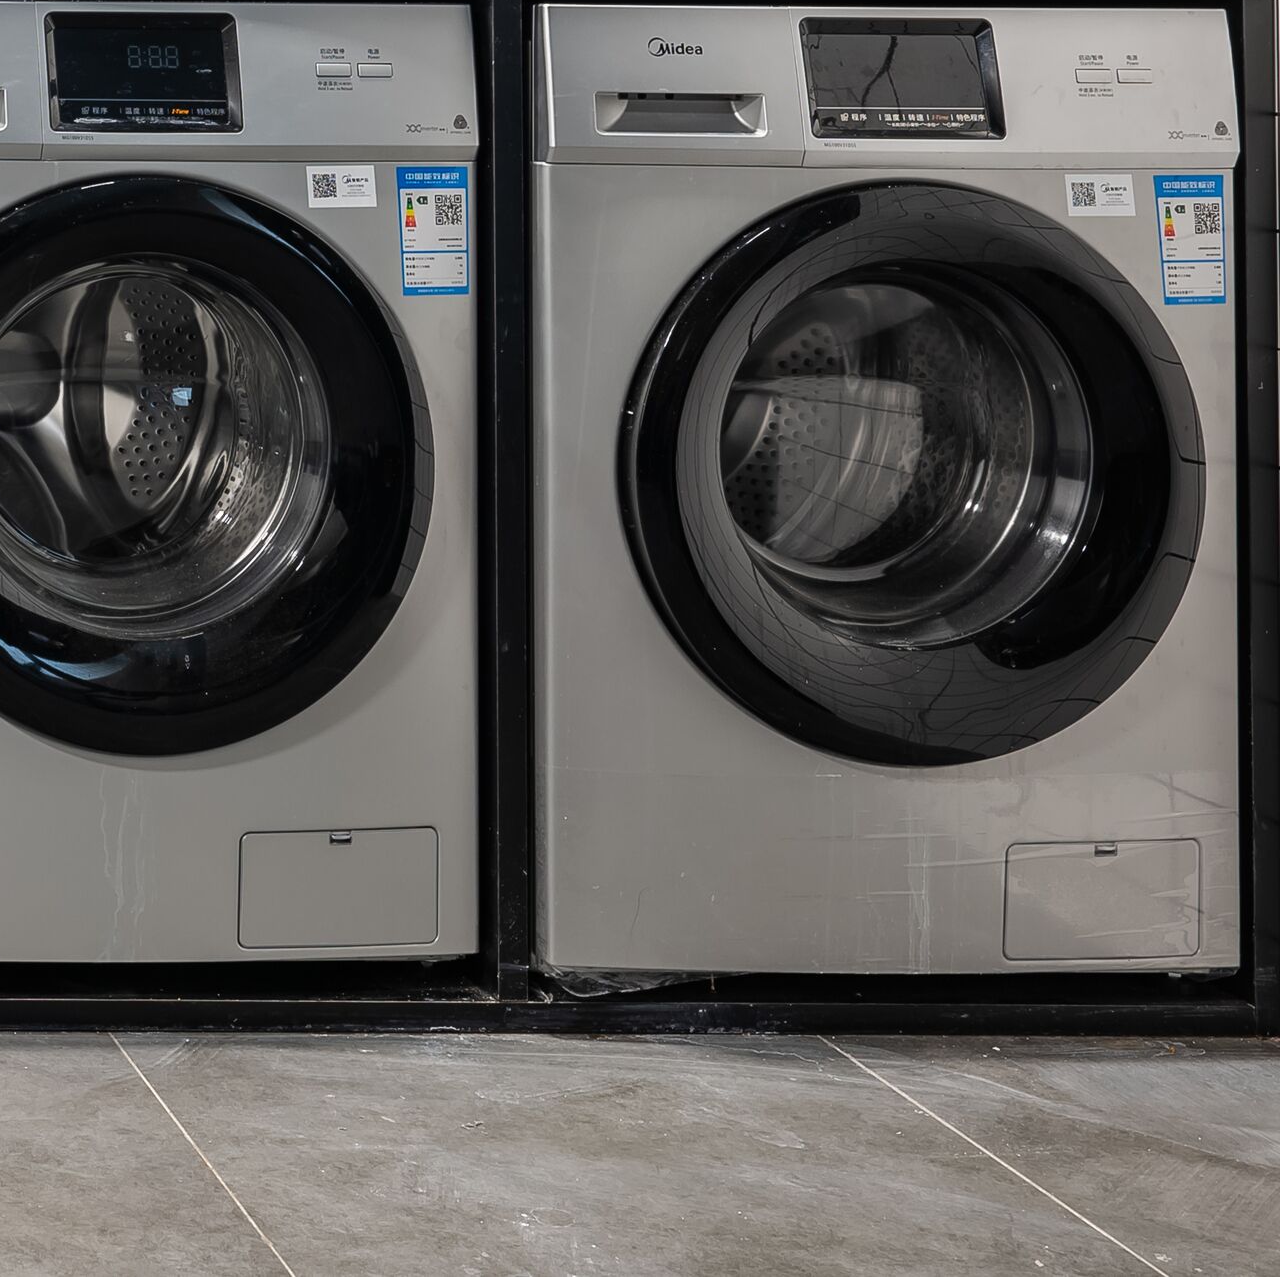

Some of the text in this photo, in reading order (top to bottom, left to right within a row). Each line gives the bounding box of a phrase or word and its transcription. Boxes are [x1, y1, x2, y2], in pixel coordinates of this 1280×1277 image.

[648, 37, 703, 57] Midea
[125, 107, 140, 115] 温度
[196, 108, 225, 116] 特色程序
[851, 114, 867, 122] 程序
[884, 114, 900, 122] 温度
[957, 114, 985, 122] 特色程序
[1163, 181, 1215, 189] 中国能效标识
